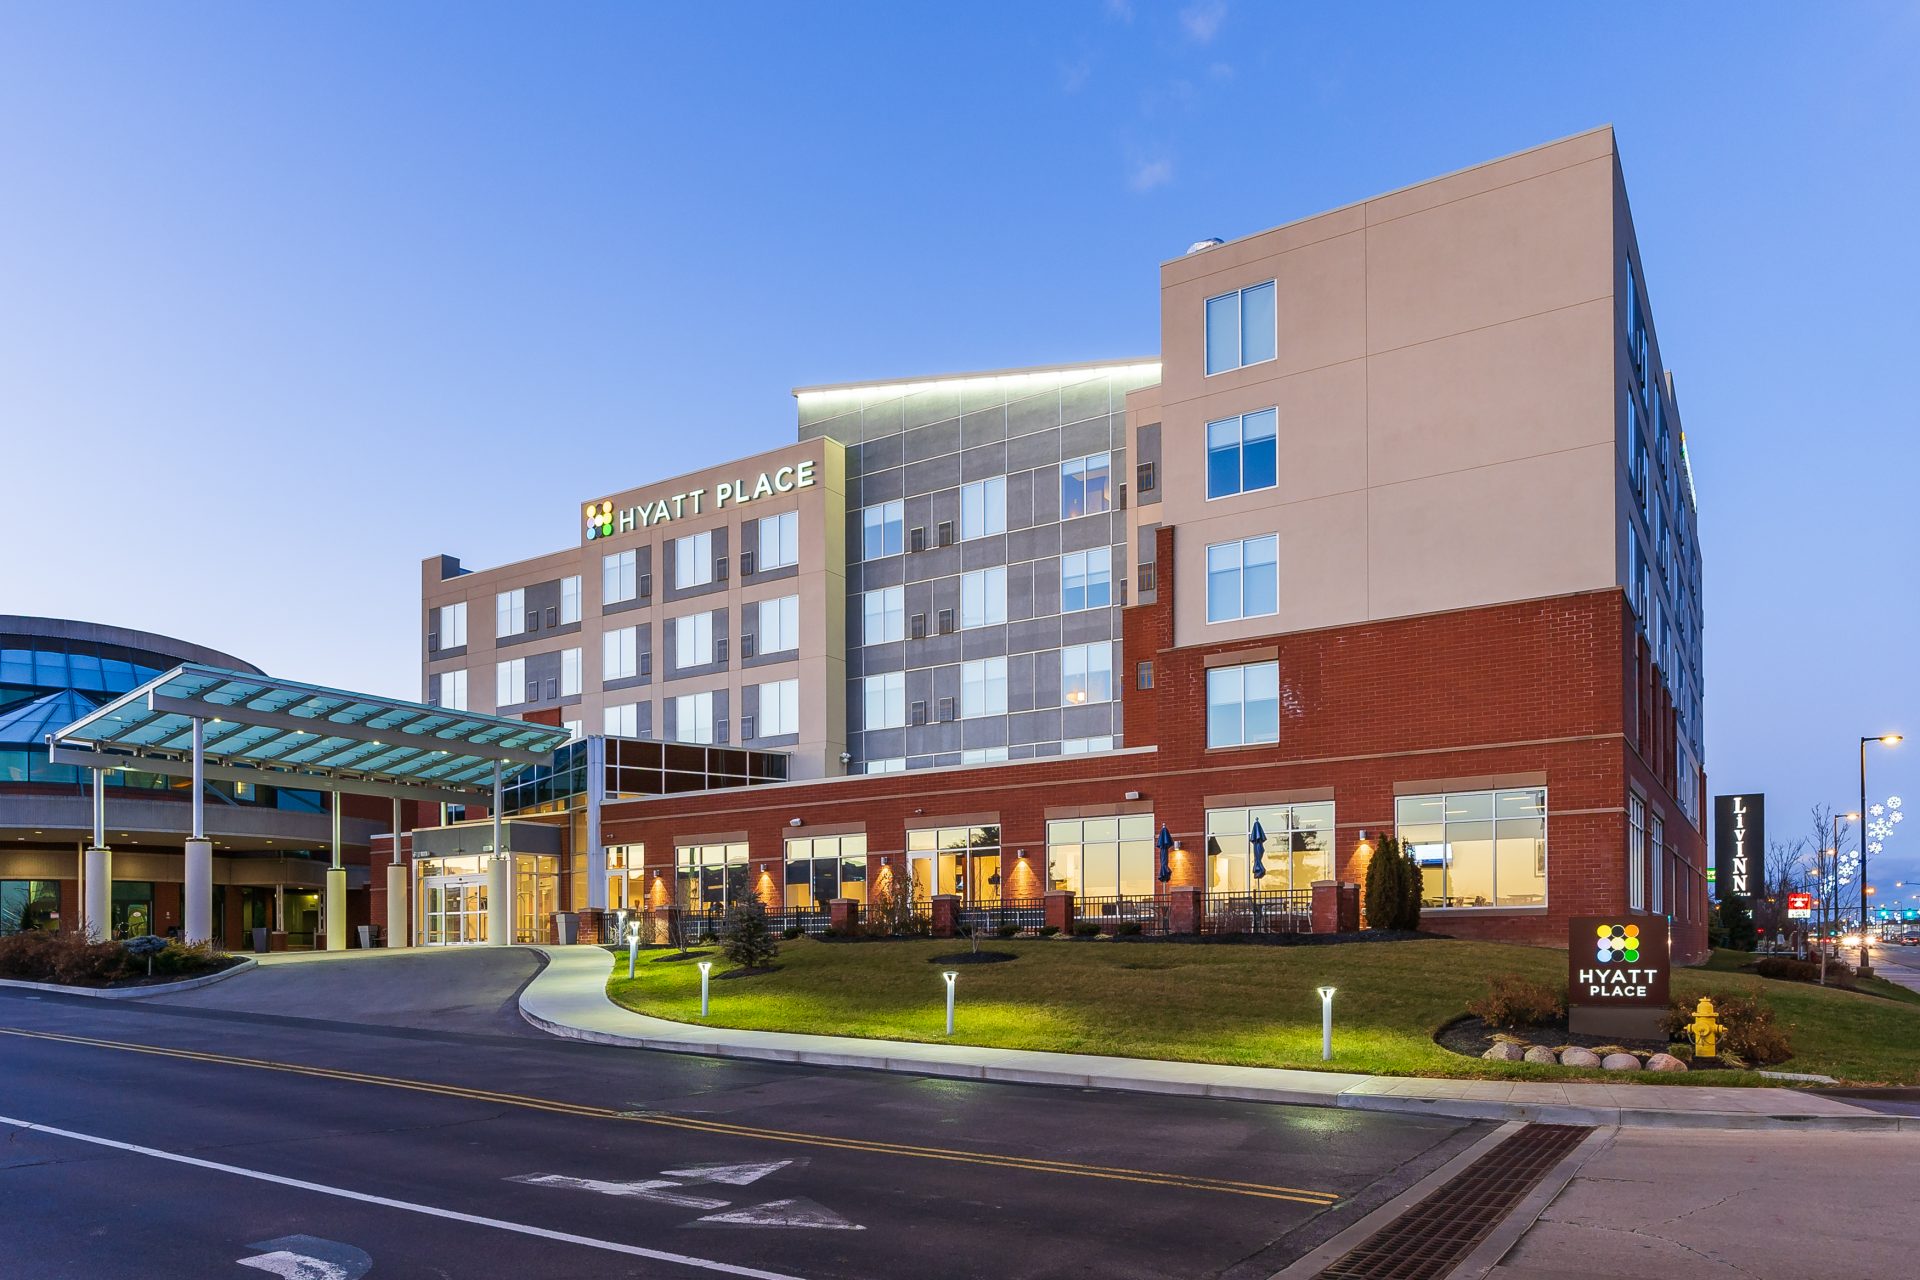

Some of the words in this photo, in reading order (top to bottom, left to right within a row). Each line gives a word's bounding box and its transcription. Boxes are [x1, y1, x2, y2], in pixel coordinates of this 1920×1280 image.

[619, 489, 705, 533] HYATT
[716, 460, 815, 508] PLACE
[1579, 969, 1658, 984] HYATT
[1590, 985, 1647, 997] PLACE
